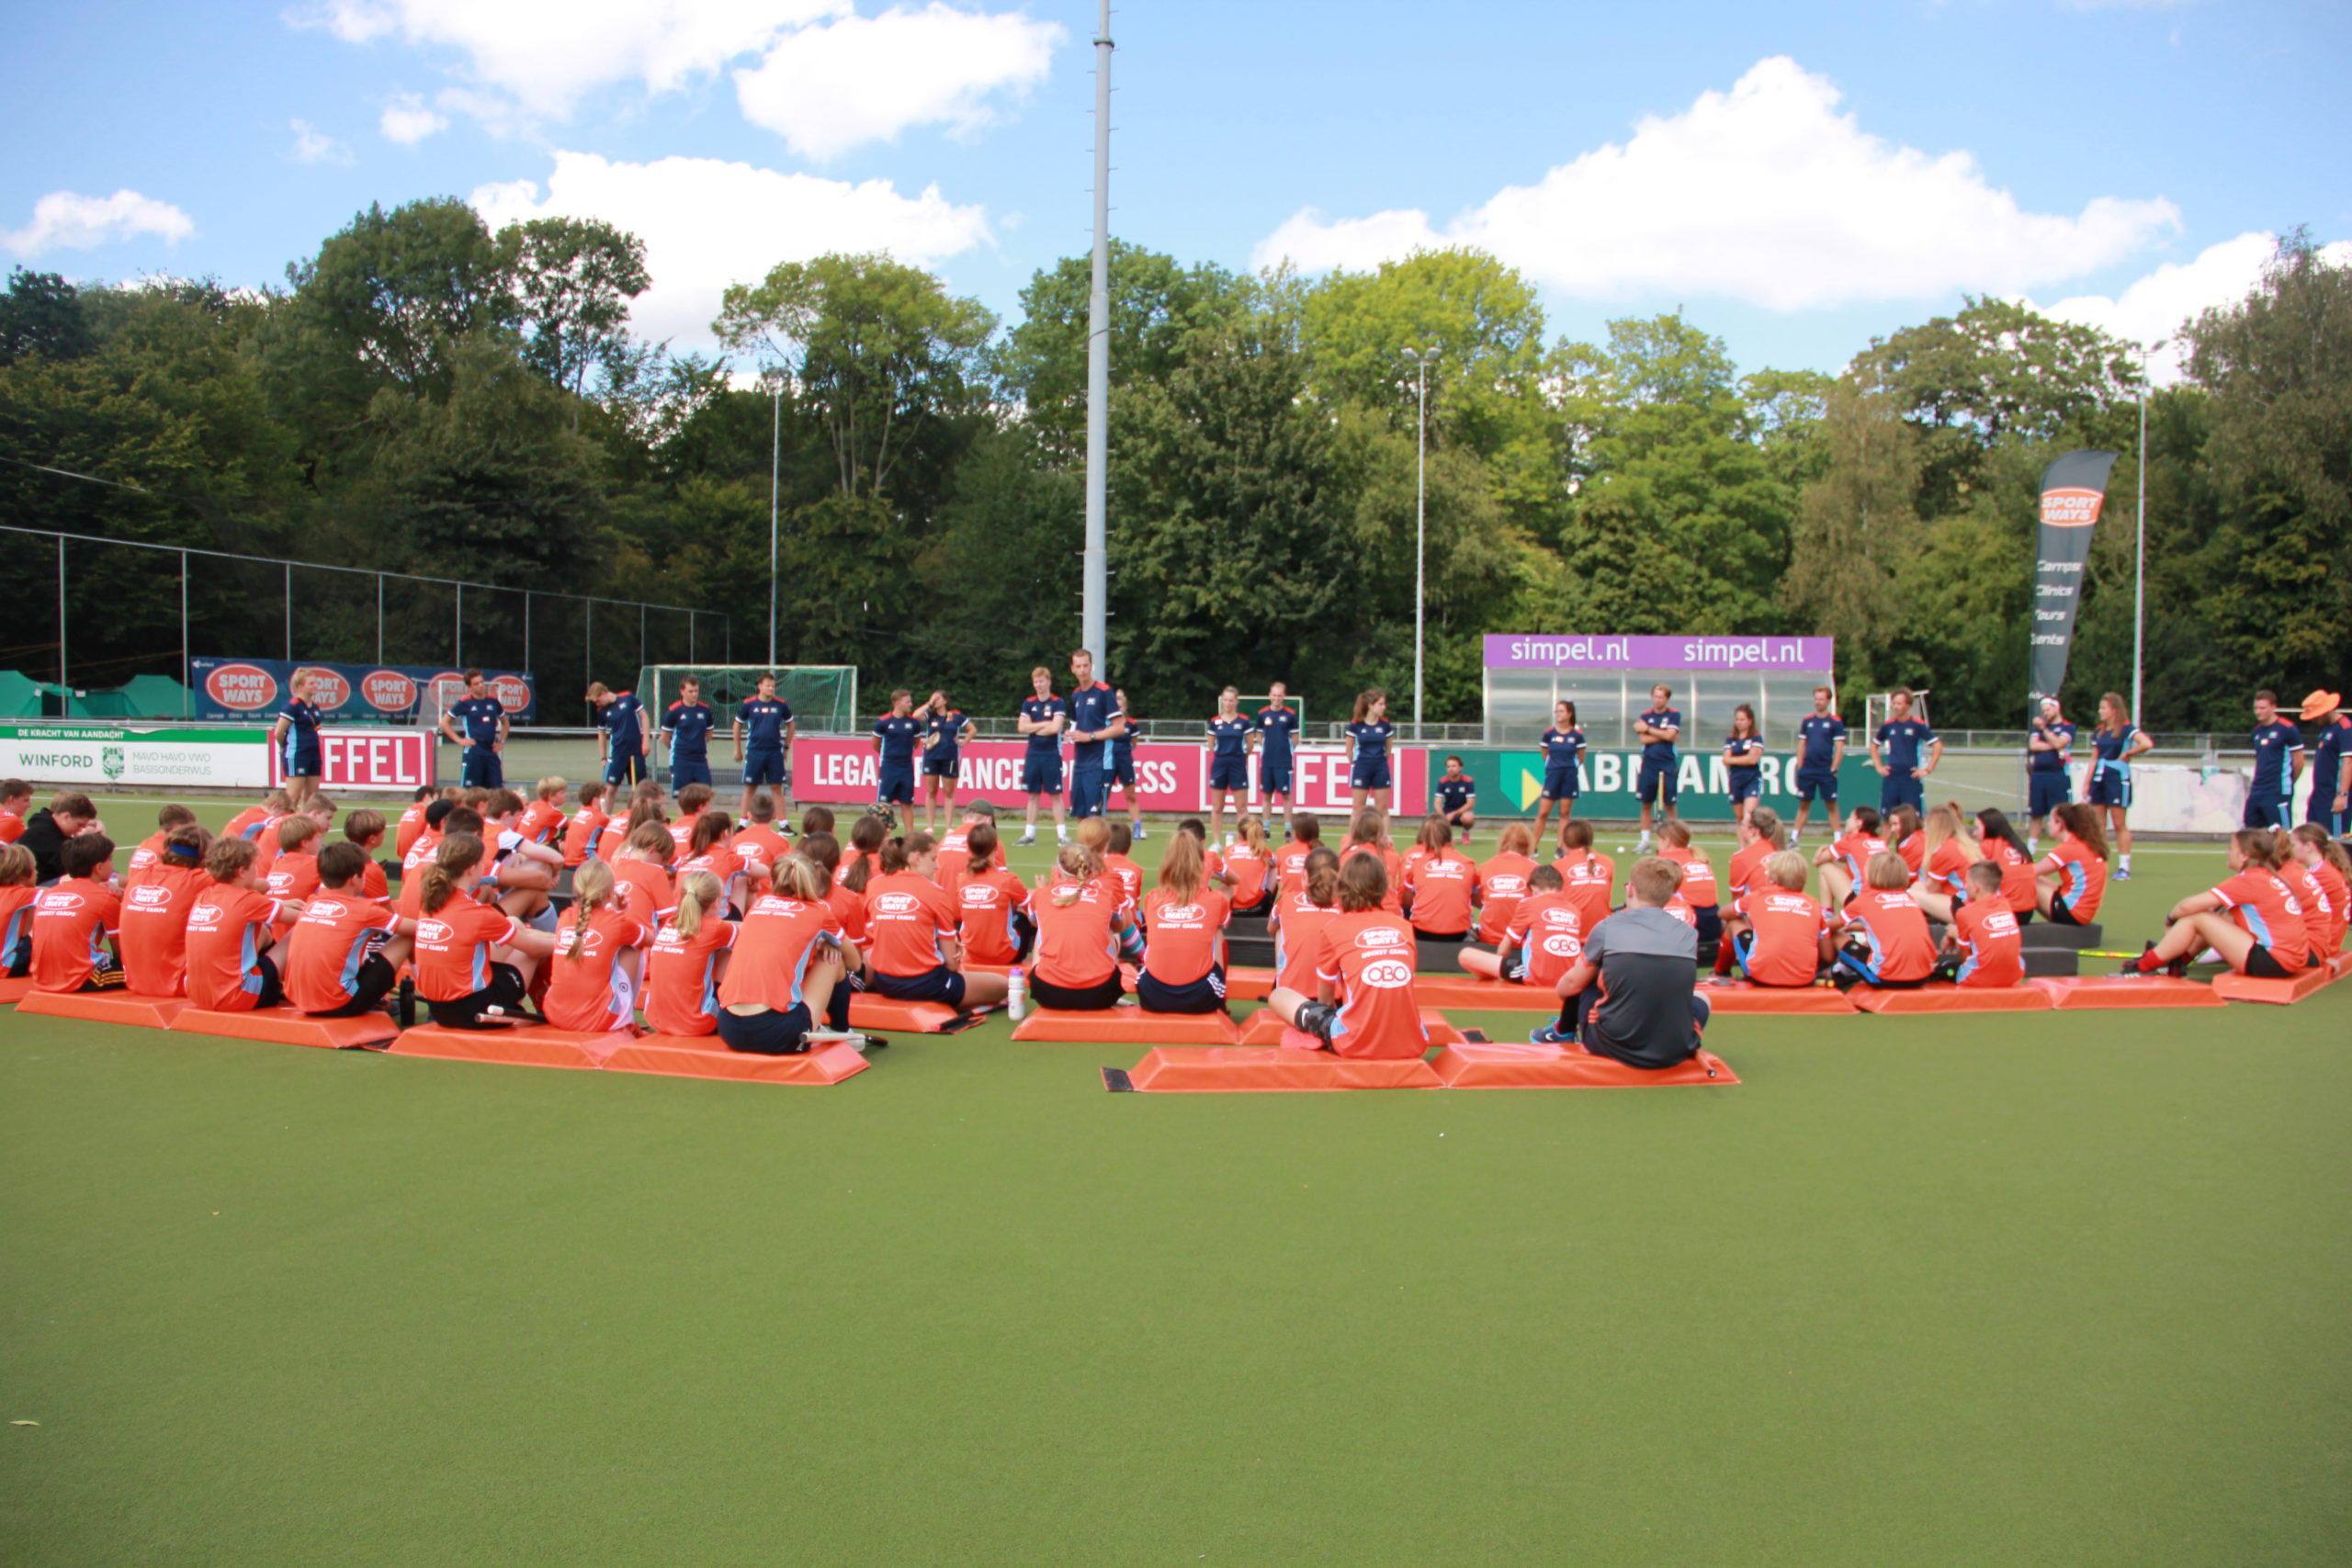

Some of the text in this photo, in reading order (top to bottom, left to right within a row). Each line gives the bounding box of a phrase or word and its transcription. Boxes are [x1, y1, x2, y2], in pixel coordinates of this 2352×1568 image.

[2041, 496, 2098, 509] SPORT
[2043, 509, 2091, 521] WAYS
[1511, 639, 1630, 666] simpel.nl
[1684, 639, 1804, 668] simpel.nl
[219, 674, 266, 688] SPORT
[315, 678, 340, 690] ORT
[371, 680, 407, 692] SPORT
[222, 690, 264, 703] WAYS
[374, 693, 406, 705] WAYS
[17, 728, 124, 739] DE KRACHT VAN AANDACHT
[19, 753, 94, 768] WINFORD
[132, 751, 211, 762] MAVO HAVO VWO
[324, 738, 416, 783] FFEL
[814, 754, 877, 786] LEGA
[881, 897, 912, 905] SPORT
[881, 903, 908, 911] WAYS
[419, 921, 446, 933] SPORT
[1363, 930, 1400, 940] SPORT
[1365, 937, 1398, 945] WAYS
[1362, 949, 1388, 959] HOCKEY
